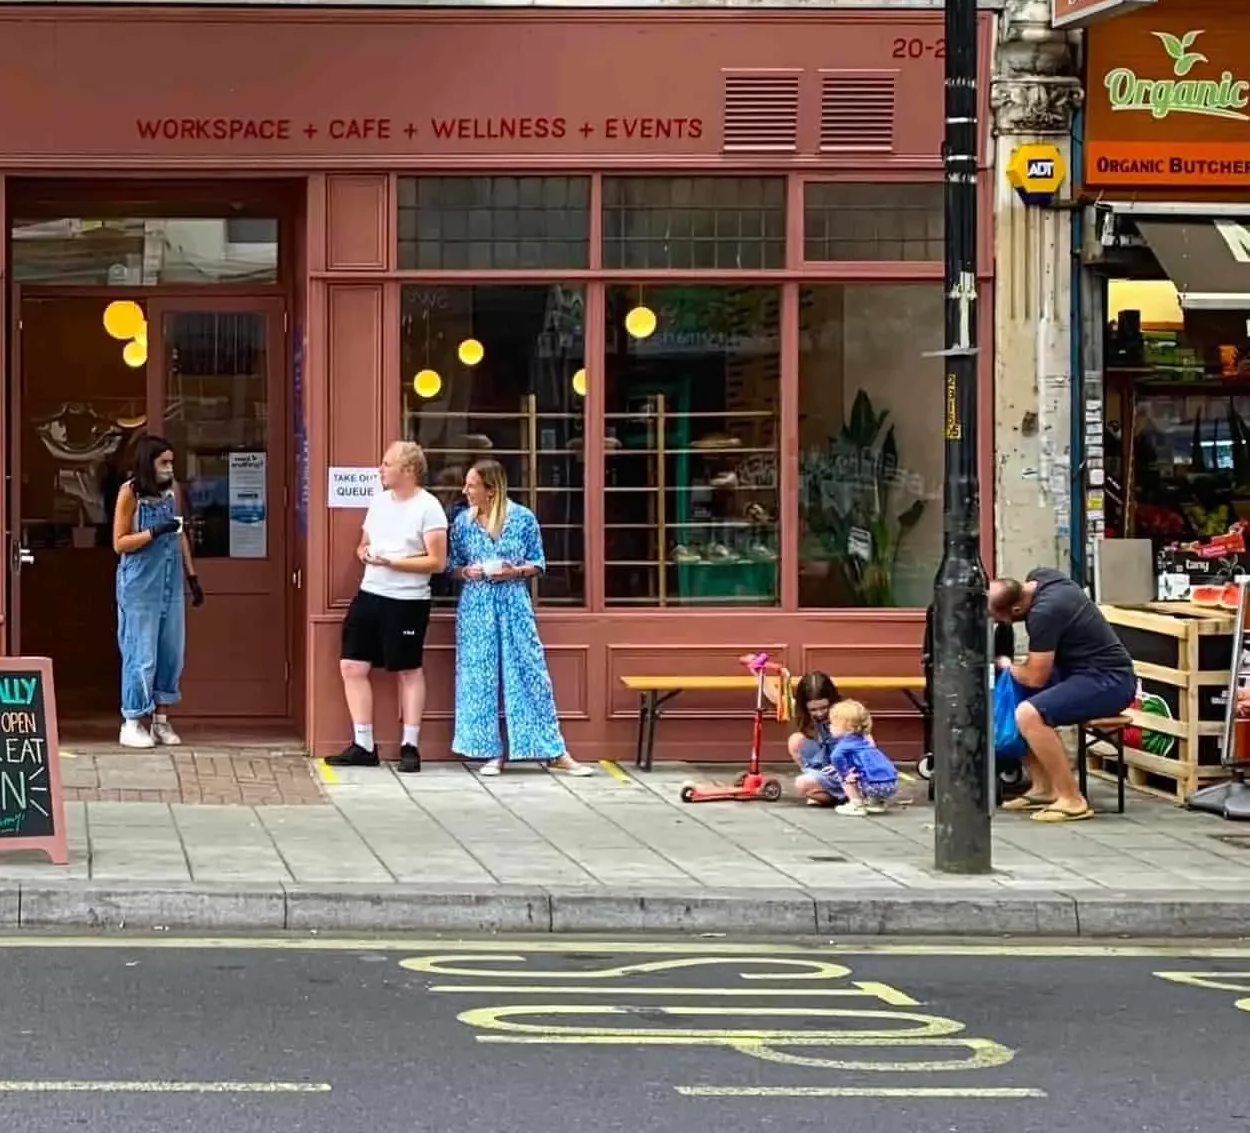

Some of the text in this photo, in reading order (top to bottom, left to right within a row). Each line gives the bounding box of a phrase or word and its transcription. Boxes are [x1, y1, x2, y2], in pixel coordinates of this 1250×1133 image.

[1104, 67, 1250, 118] Organic
[136, 117, 704, 140] WORKSPACE + CAFE + WELLNESS + EVENTS
[1028, 161, 1054, 177] ADT
[1096, 155, 1164, 174] ORGANIC
[333, 474, 357, 482] TAKE
[336, 487, 374, 497] QUEUE
[0, 712, 37, 733] OPEN
[6, 738, 45, 764] EAT
[398, 954, 1016, 1072] STOP
